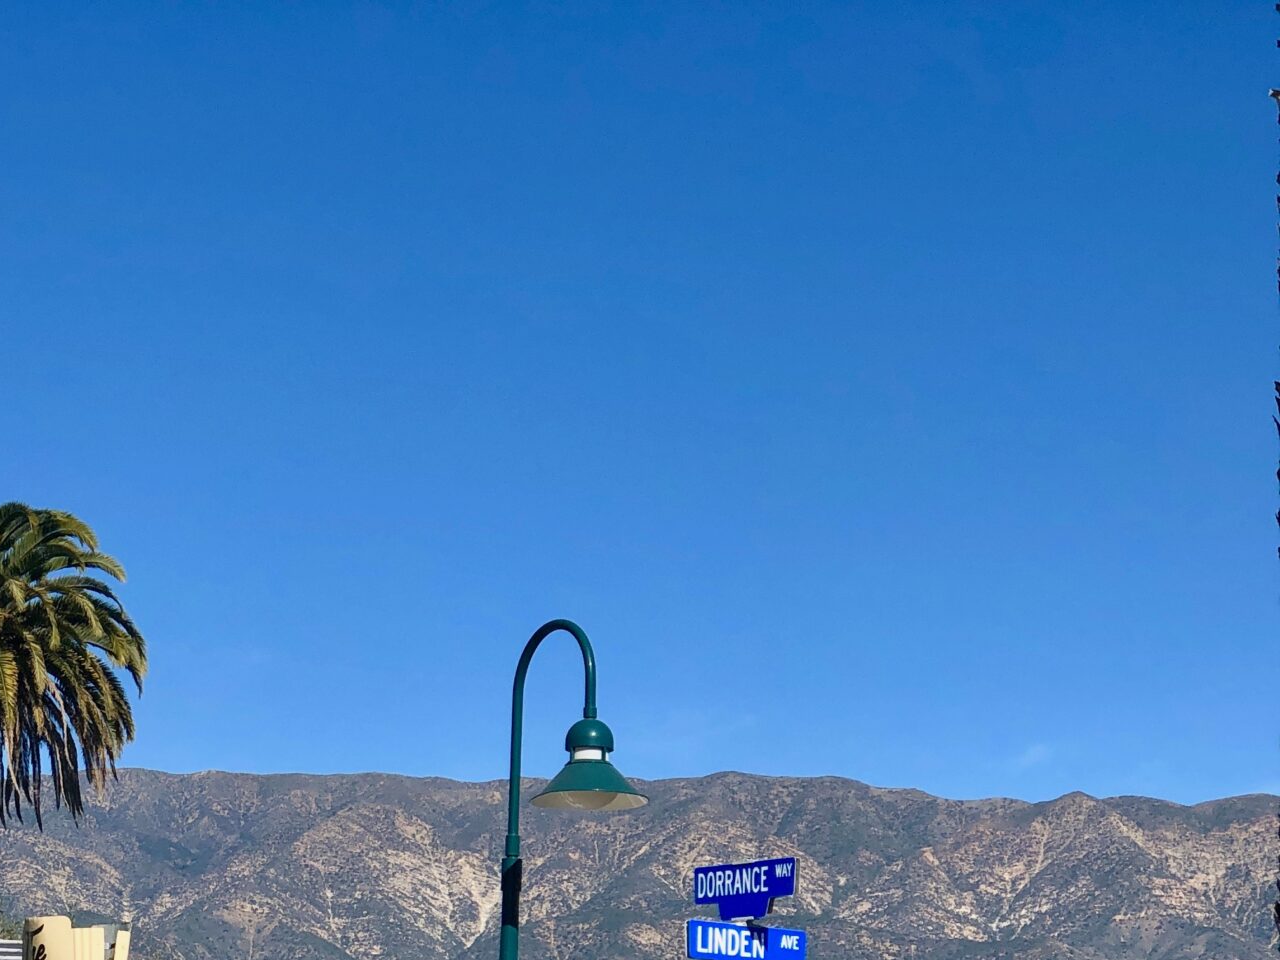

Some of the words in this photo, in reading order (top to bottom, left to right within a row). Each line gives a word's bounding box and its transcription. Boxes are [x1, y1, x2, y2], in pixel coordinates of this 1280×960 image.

[697, 866, 769, 898] DORRANCE
[775, 863, 793, 878] WAY
[696, 925, 765, 959] LINDEN
[781, 934, 800, 950] AVE
